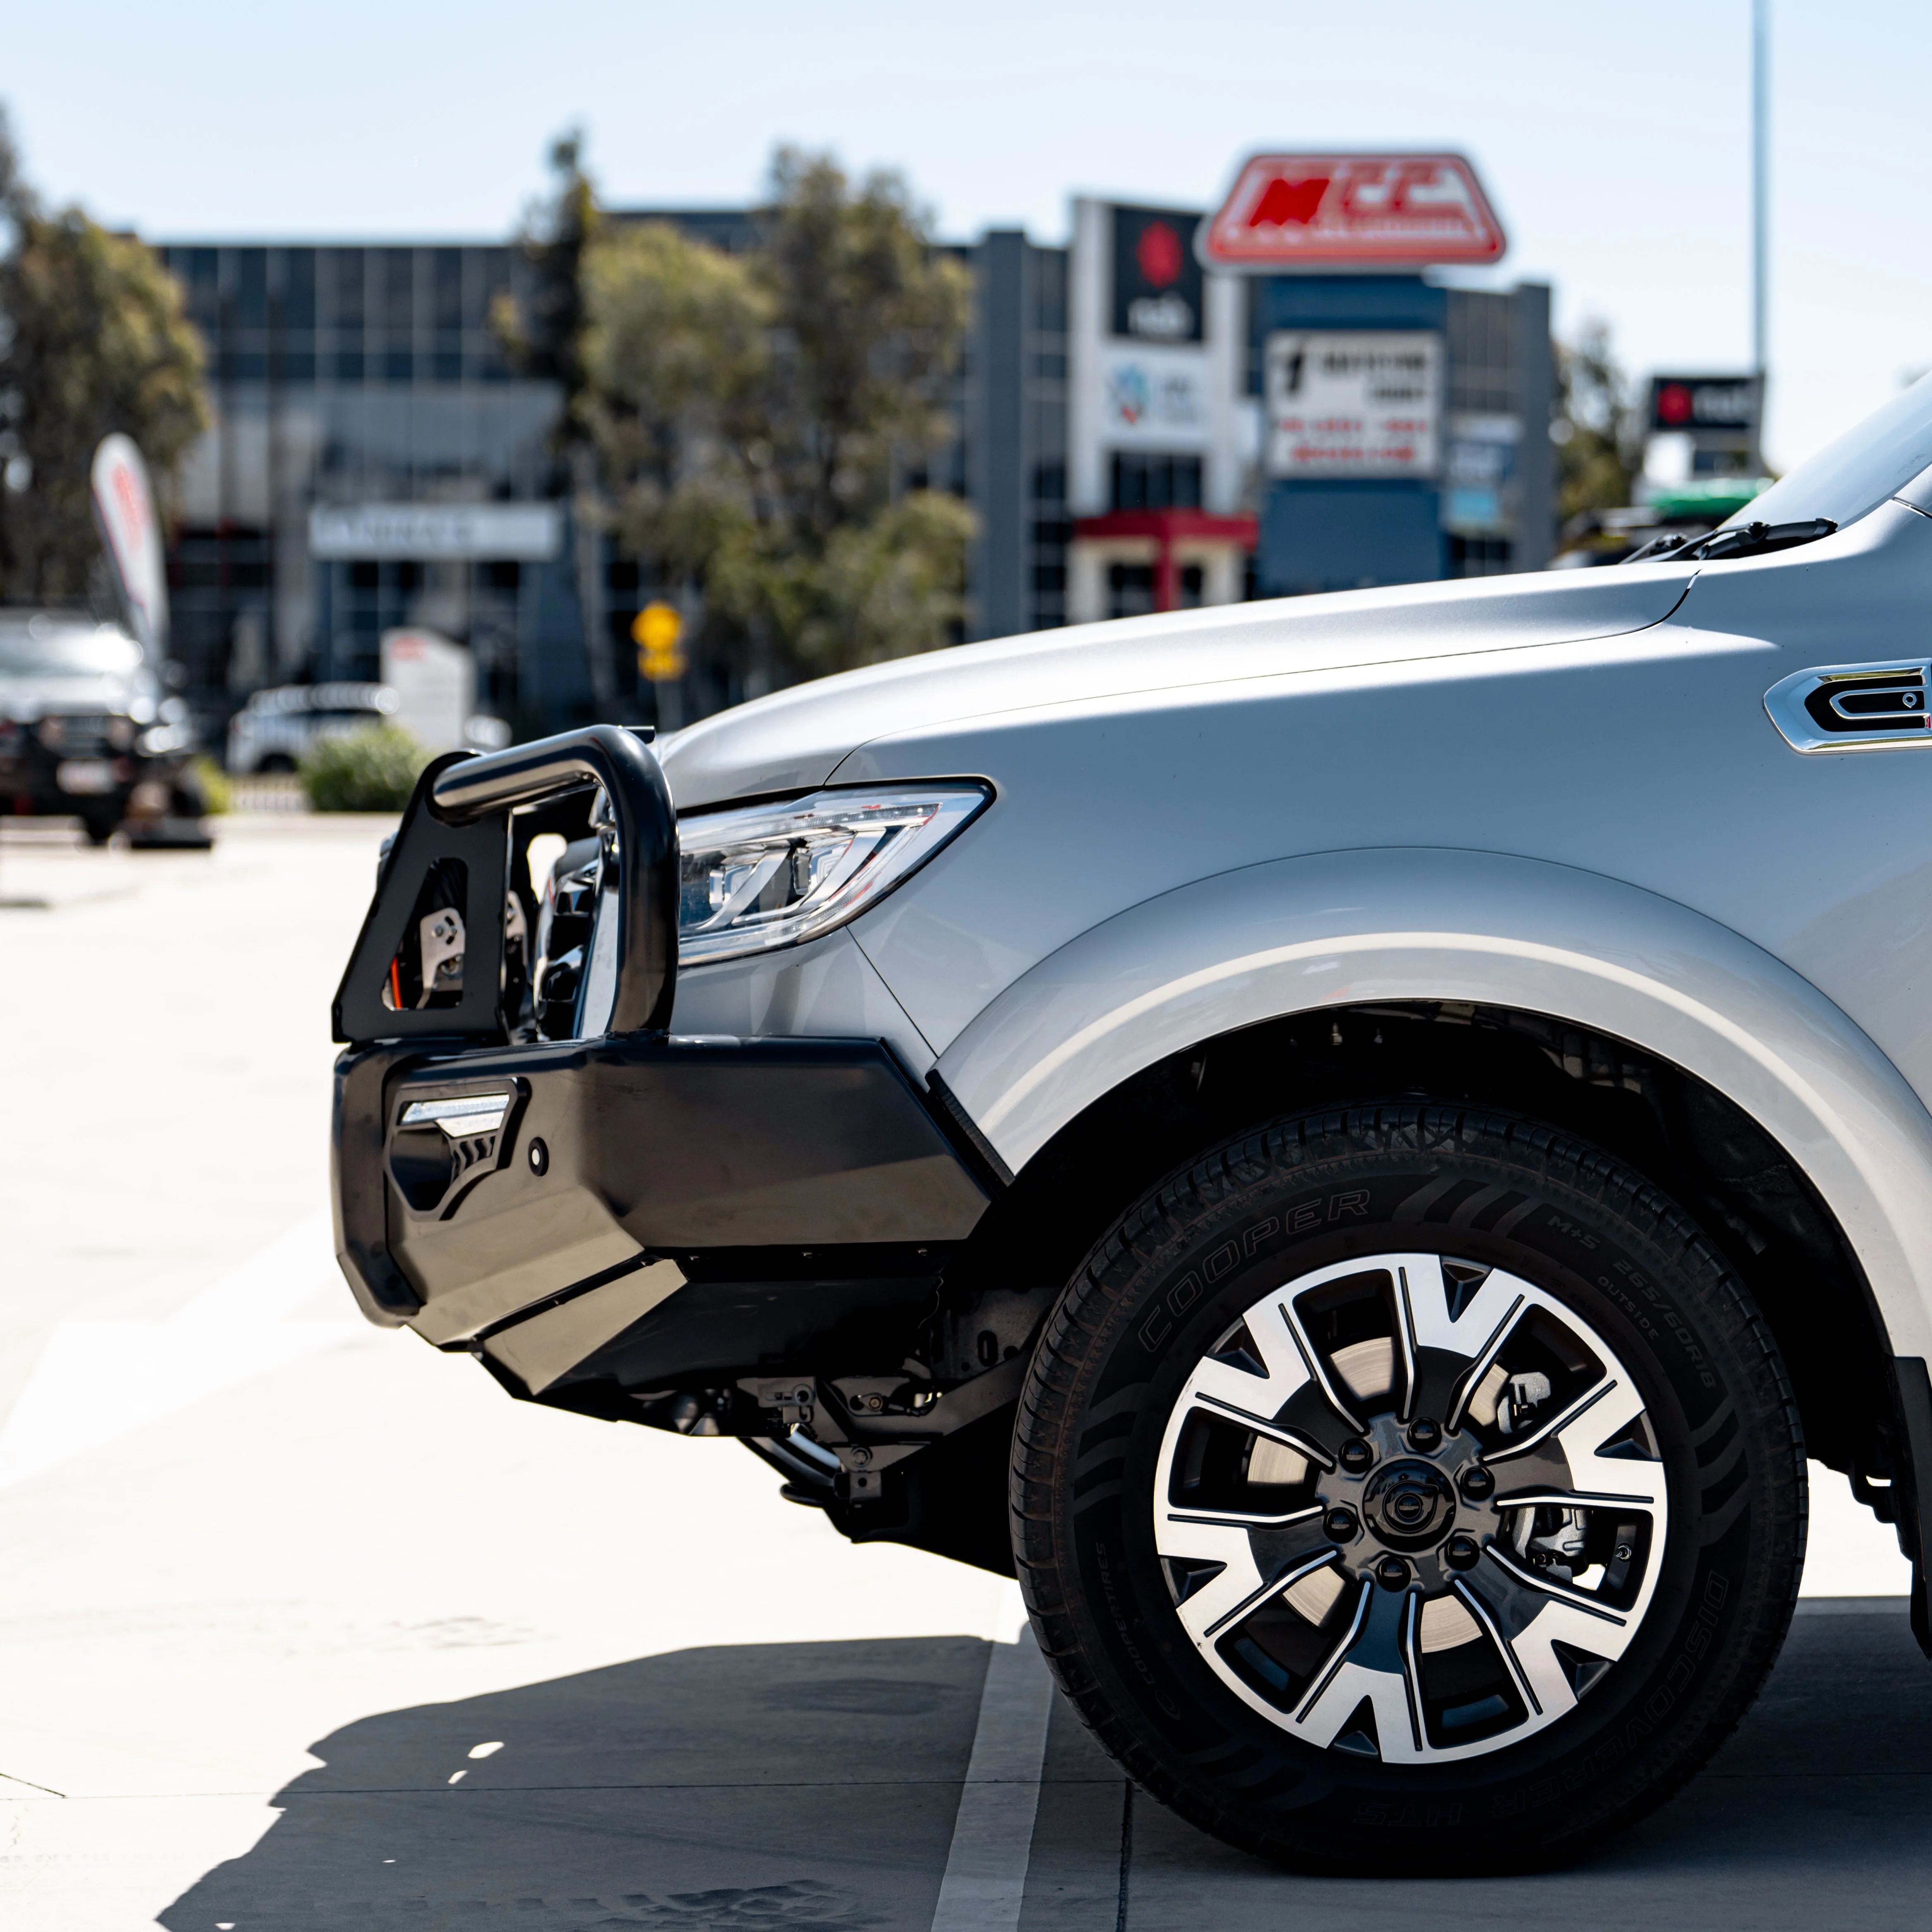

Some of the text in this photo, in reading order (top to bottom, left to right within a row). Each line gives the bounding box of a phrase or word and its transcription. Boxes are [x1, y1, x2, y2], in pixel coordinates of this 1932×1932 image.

[1138, 1188, 1370, 1353] COOPER
[1546, 1215, 1601, 1249] M+S
[1612, 1259, 1717, 1389] 265/60R18
[1597, 1275, 1660, 1340] OUTSIDE
[1095, 1542, 1156, 1685] COOPERTIRES
[1351, 1571, 1730, 1827] DISCOVERER HTS
